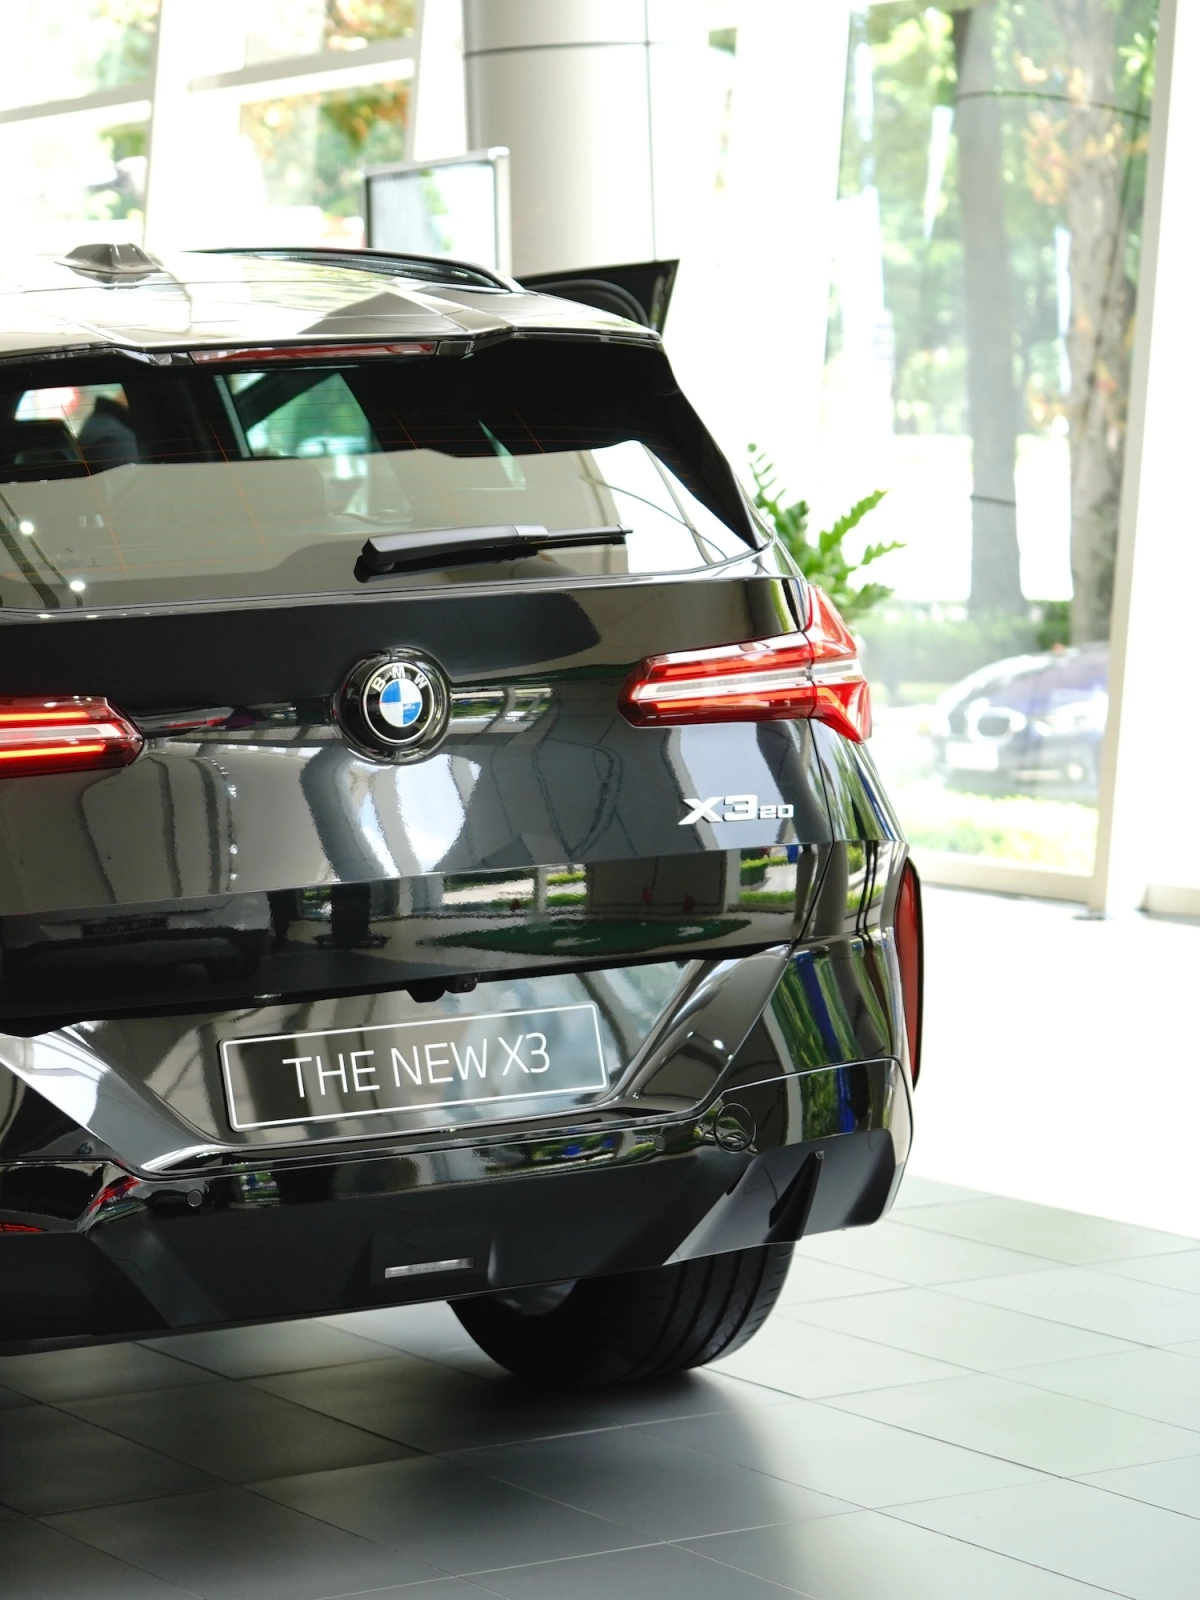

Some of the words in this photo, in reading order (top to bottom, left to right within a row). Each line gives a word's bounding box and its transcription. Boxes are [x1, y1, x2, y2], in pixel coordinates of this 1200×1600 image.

[372, 665, 428, 692] BMW
[282, 1050, 380, 1098] THE
[391, 1038, 489, 1088] NEW
[497, 1032, 550, 1076] X3
